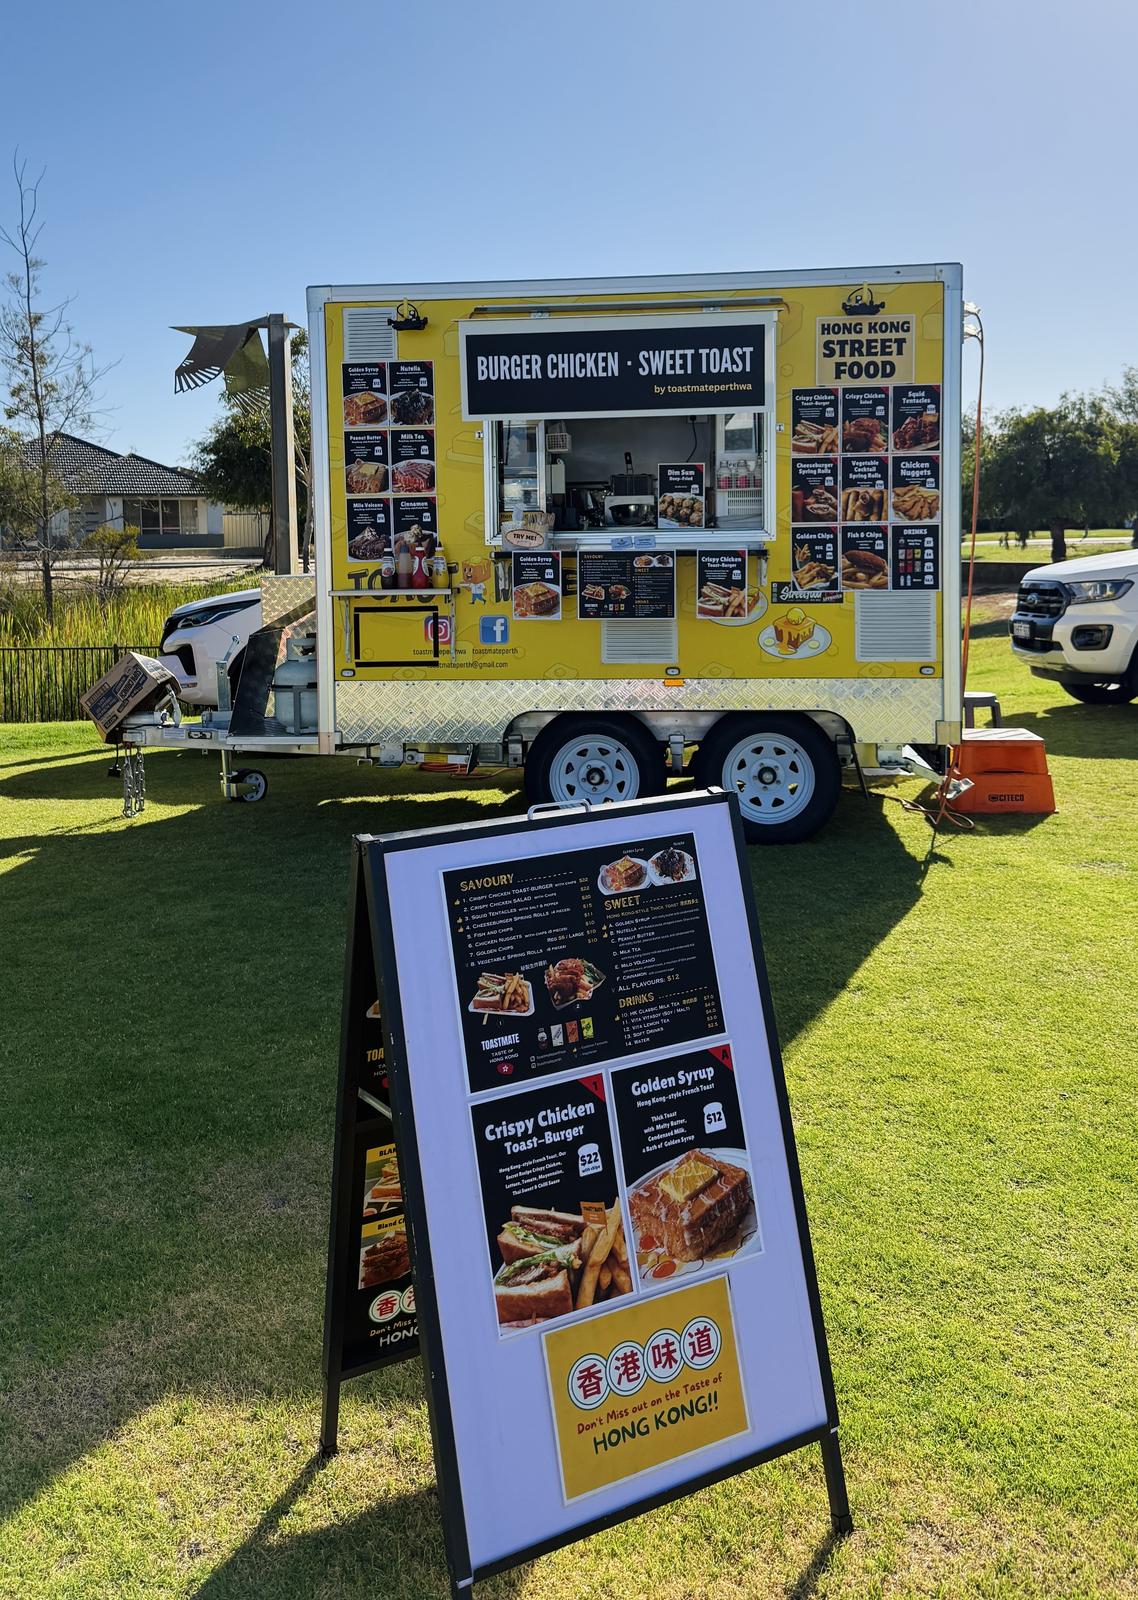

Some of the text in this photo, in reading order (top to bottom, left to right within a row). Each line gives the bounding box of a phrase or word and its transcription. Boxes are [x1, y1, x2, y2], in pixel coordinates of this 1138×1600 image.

[821, 321, 910, 335] HONG KONG
[822, 338, 906, 358] STREET
[477, 347, 754, 380] BURGER CHICKEN SWEET TOAST
[834, 360, 896, 380] FOOD
[654, 382, 752, 395] by toastmateperthwa
[460, 873, 514, 892] SAVOURY
[604, 895, 640, 910] SWEET
[619, 992, 654, 1008] DRINKS
[481, 1033, 520, 1050] TOASTMATE
[722, 1049, 728, 1060] A
[592, 1081, 598, 1091] 1
[631, 1067, 714, 1096] Golden Syrup
[636, 1083, 714, 1108] Hong Kong-style French Toast
[485, 1102, 594, 1141] Crispy Chicken
[706, 1111, 722, 1124] $12
[504, 1125, 584, 1155] Toast-Burger
[648, 1130, 673, 1142] Condensed
[664, 1139, 680, 1147] Golden
[579, 1152, 598, 1166] $22
[378, 1220, 396, 1230] Bland
[370, 1320, 412, 1337] Don't Miss
[576, 1325, 714, 1400] 香港味道
[577, 1372, 722, 1434] Don't Miss out on the Taste of
[593, 1390, 718, 1454] HONG KONG!!
